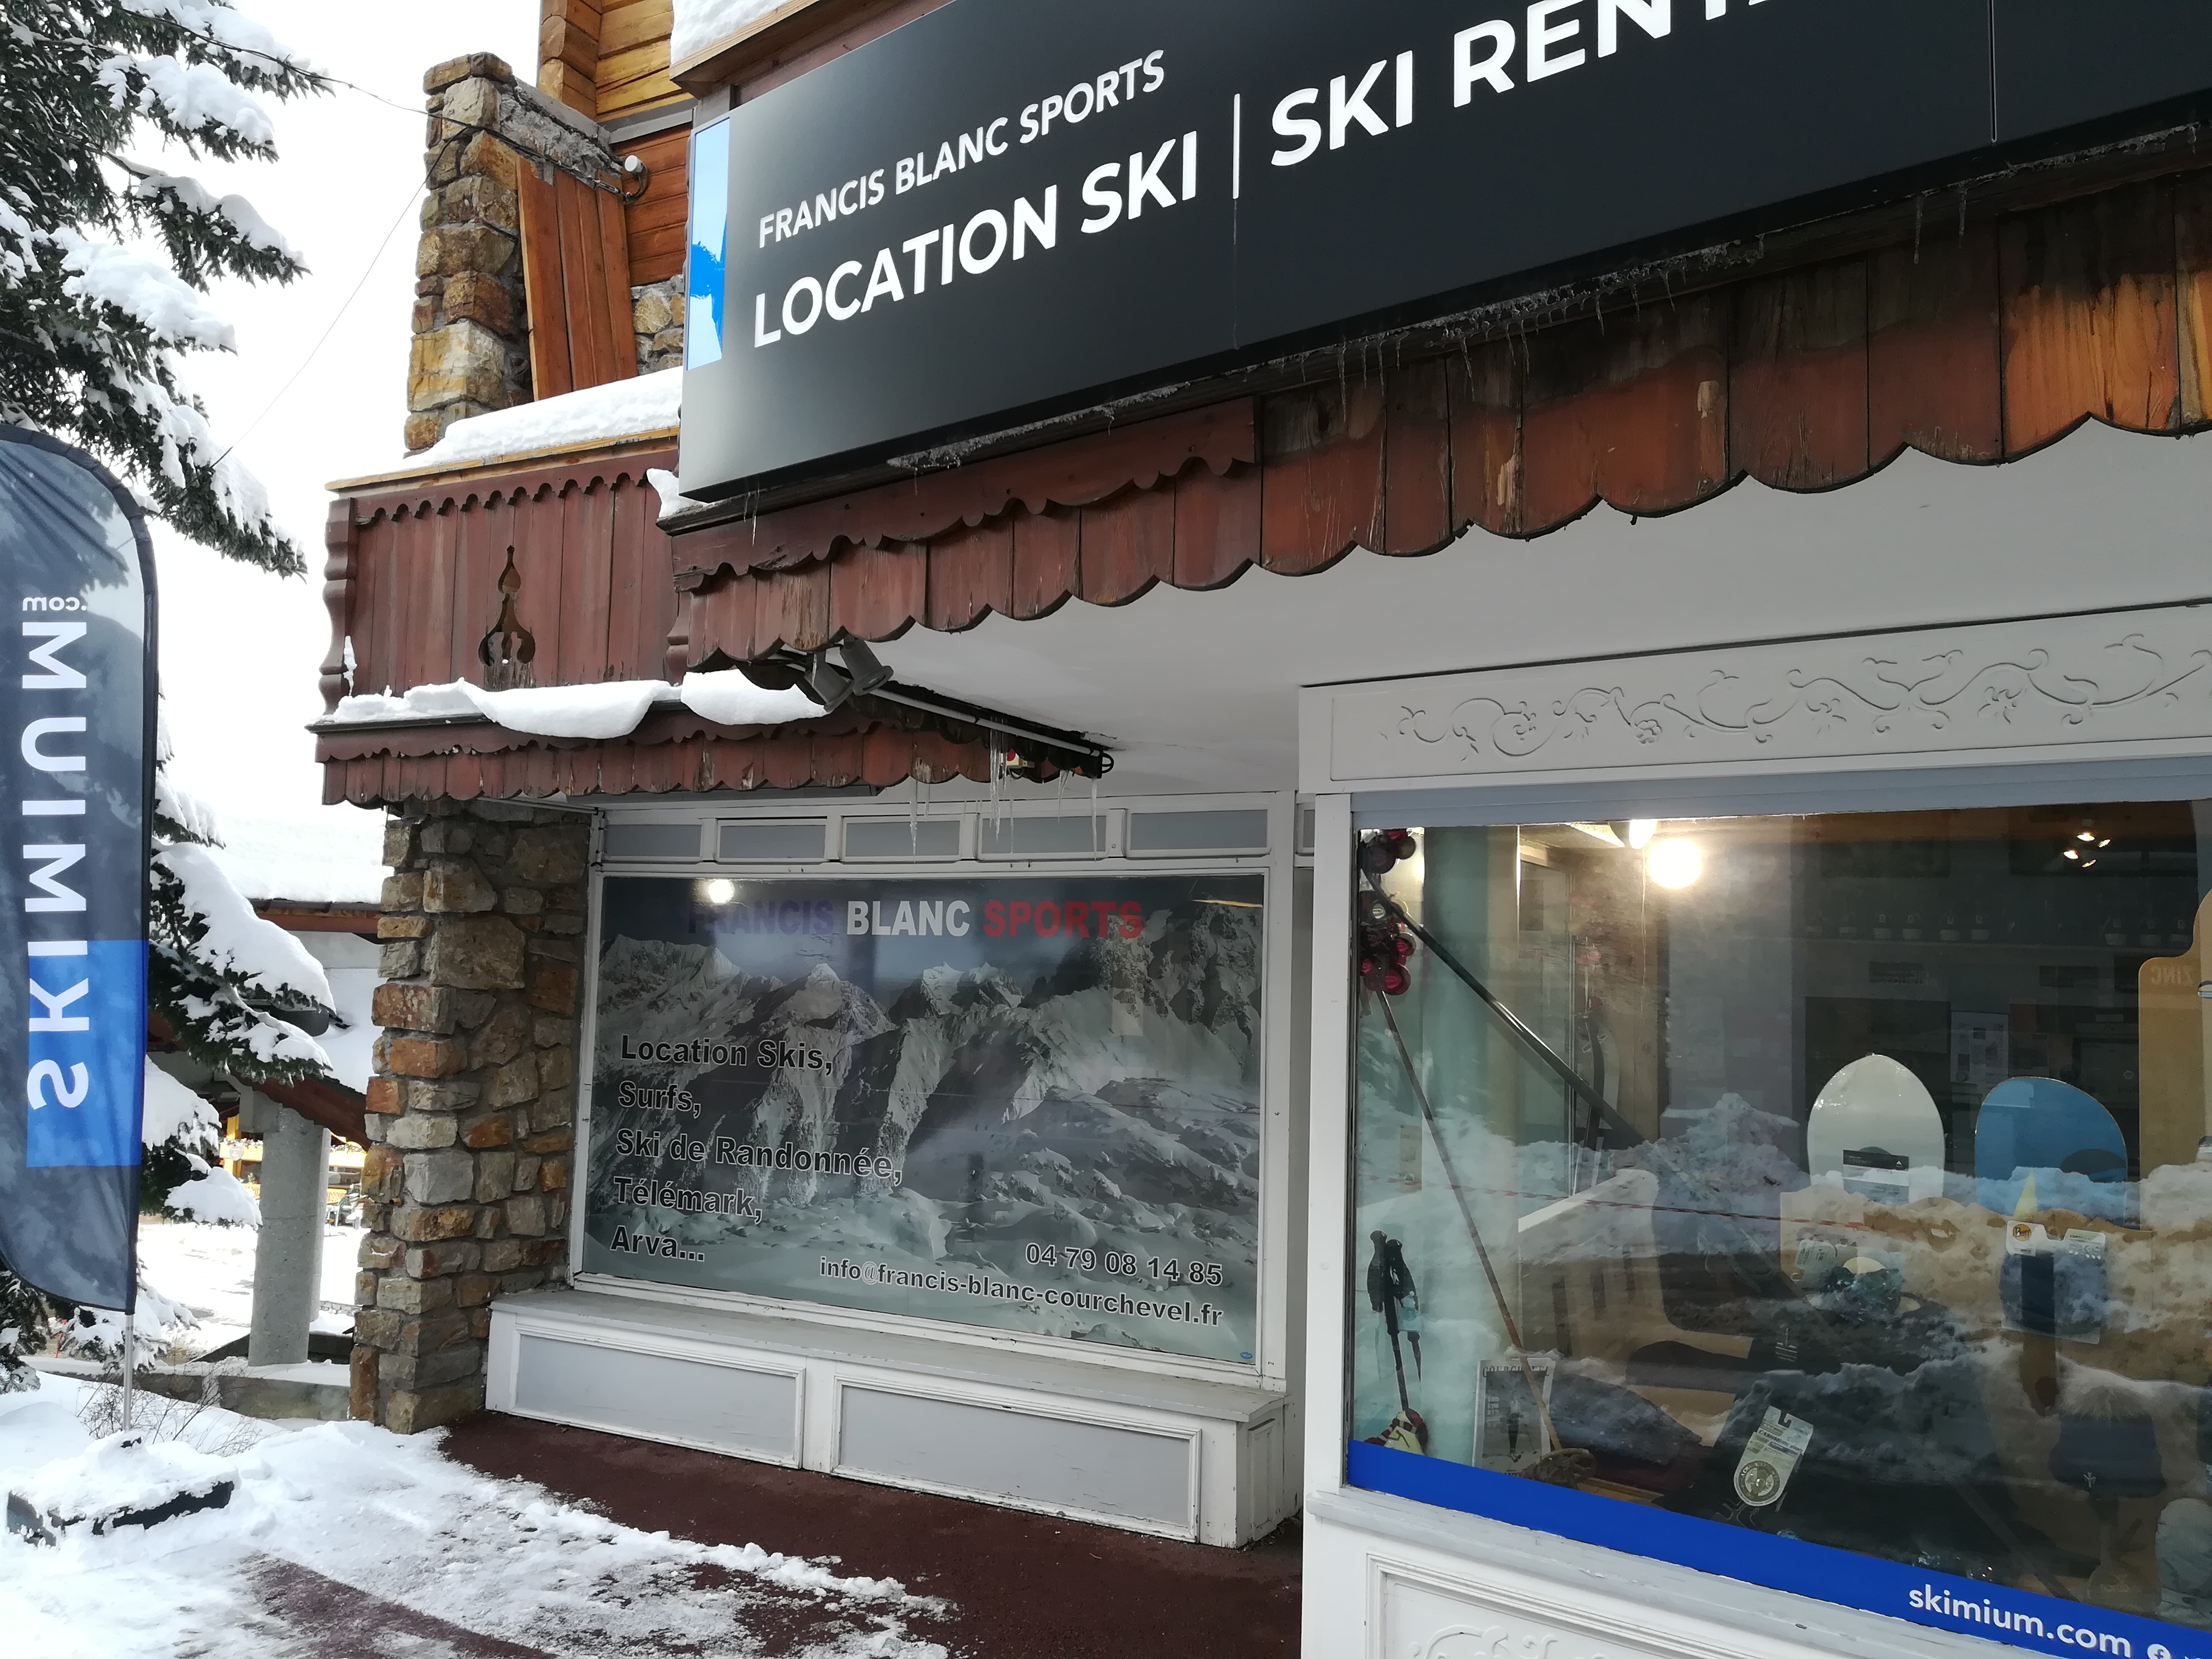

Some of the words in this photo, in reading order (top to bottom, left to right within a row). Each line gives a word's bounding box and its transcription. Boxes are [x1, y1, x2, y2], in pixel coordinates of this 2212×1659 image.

[754, 185, 1057, 348] LOCATION
[1080, 130, 1197, 234] SKI
[1271, 50, 1413, 166] SKI
[1453, 0, 1767, 107] REN
[759, 169, 885, 249] FRANCIS
[895, 118, 1008, 195] BLANC
[1020, 50, 1165, 144] SPORTS
[846, 900, 971, 937] BLANC
[983, 900, 1144, 939] SPORTS
[621, 1035, 747, 1066] Location
[758, 1039, 833, 1076] Skis,
[618, 1080, 701, 1118] Surfs,
[616, 1128, 659, 1157] Ski
[670, 1133, 706, 1162] de
[716, 1136, 903, 1186] Randonnée,
[614, 1175, 763, 1224] Télémark,
[610, 1225, 705, 1262] Arva...
[1025, 1243, 1058, 1267] 04
[1065, 1246, 1096, 1272] 79
[1105, 1250, 1138, 1278] 08
[1147, 1255, 1181, 1282] 14
[1189, 1261, 1224, 1286] 85
[819, 1256, 1224, 1327] info@francis-blanc-courchevel.fr
[1909, 1584, 2131, 1658] skimium.com
